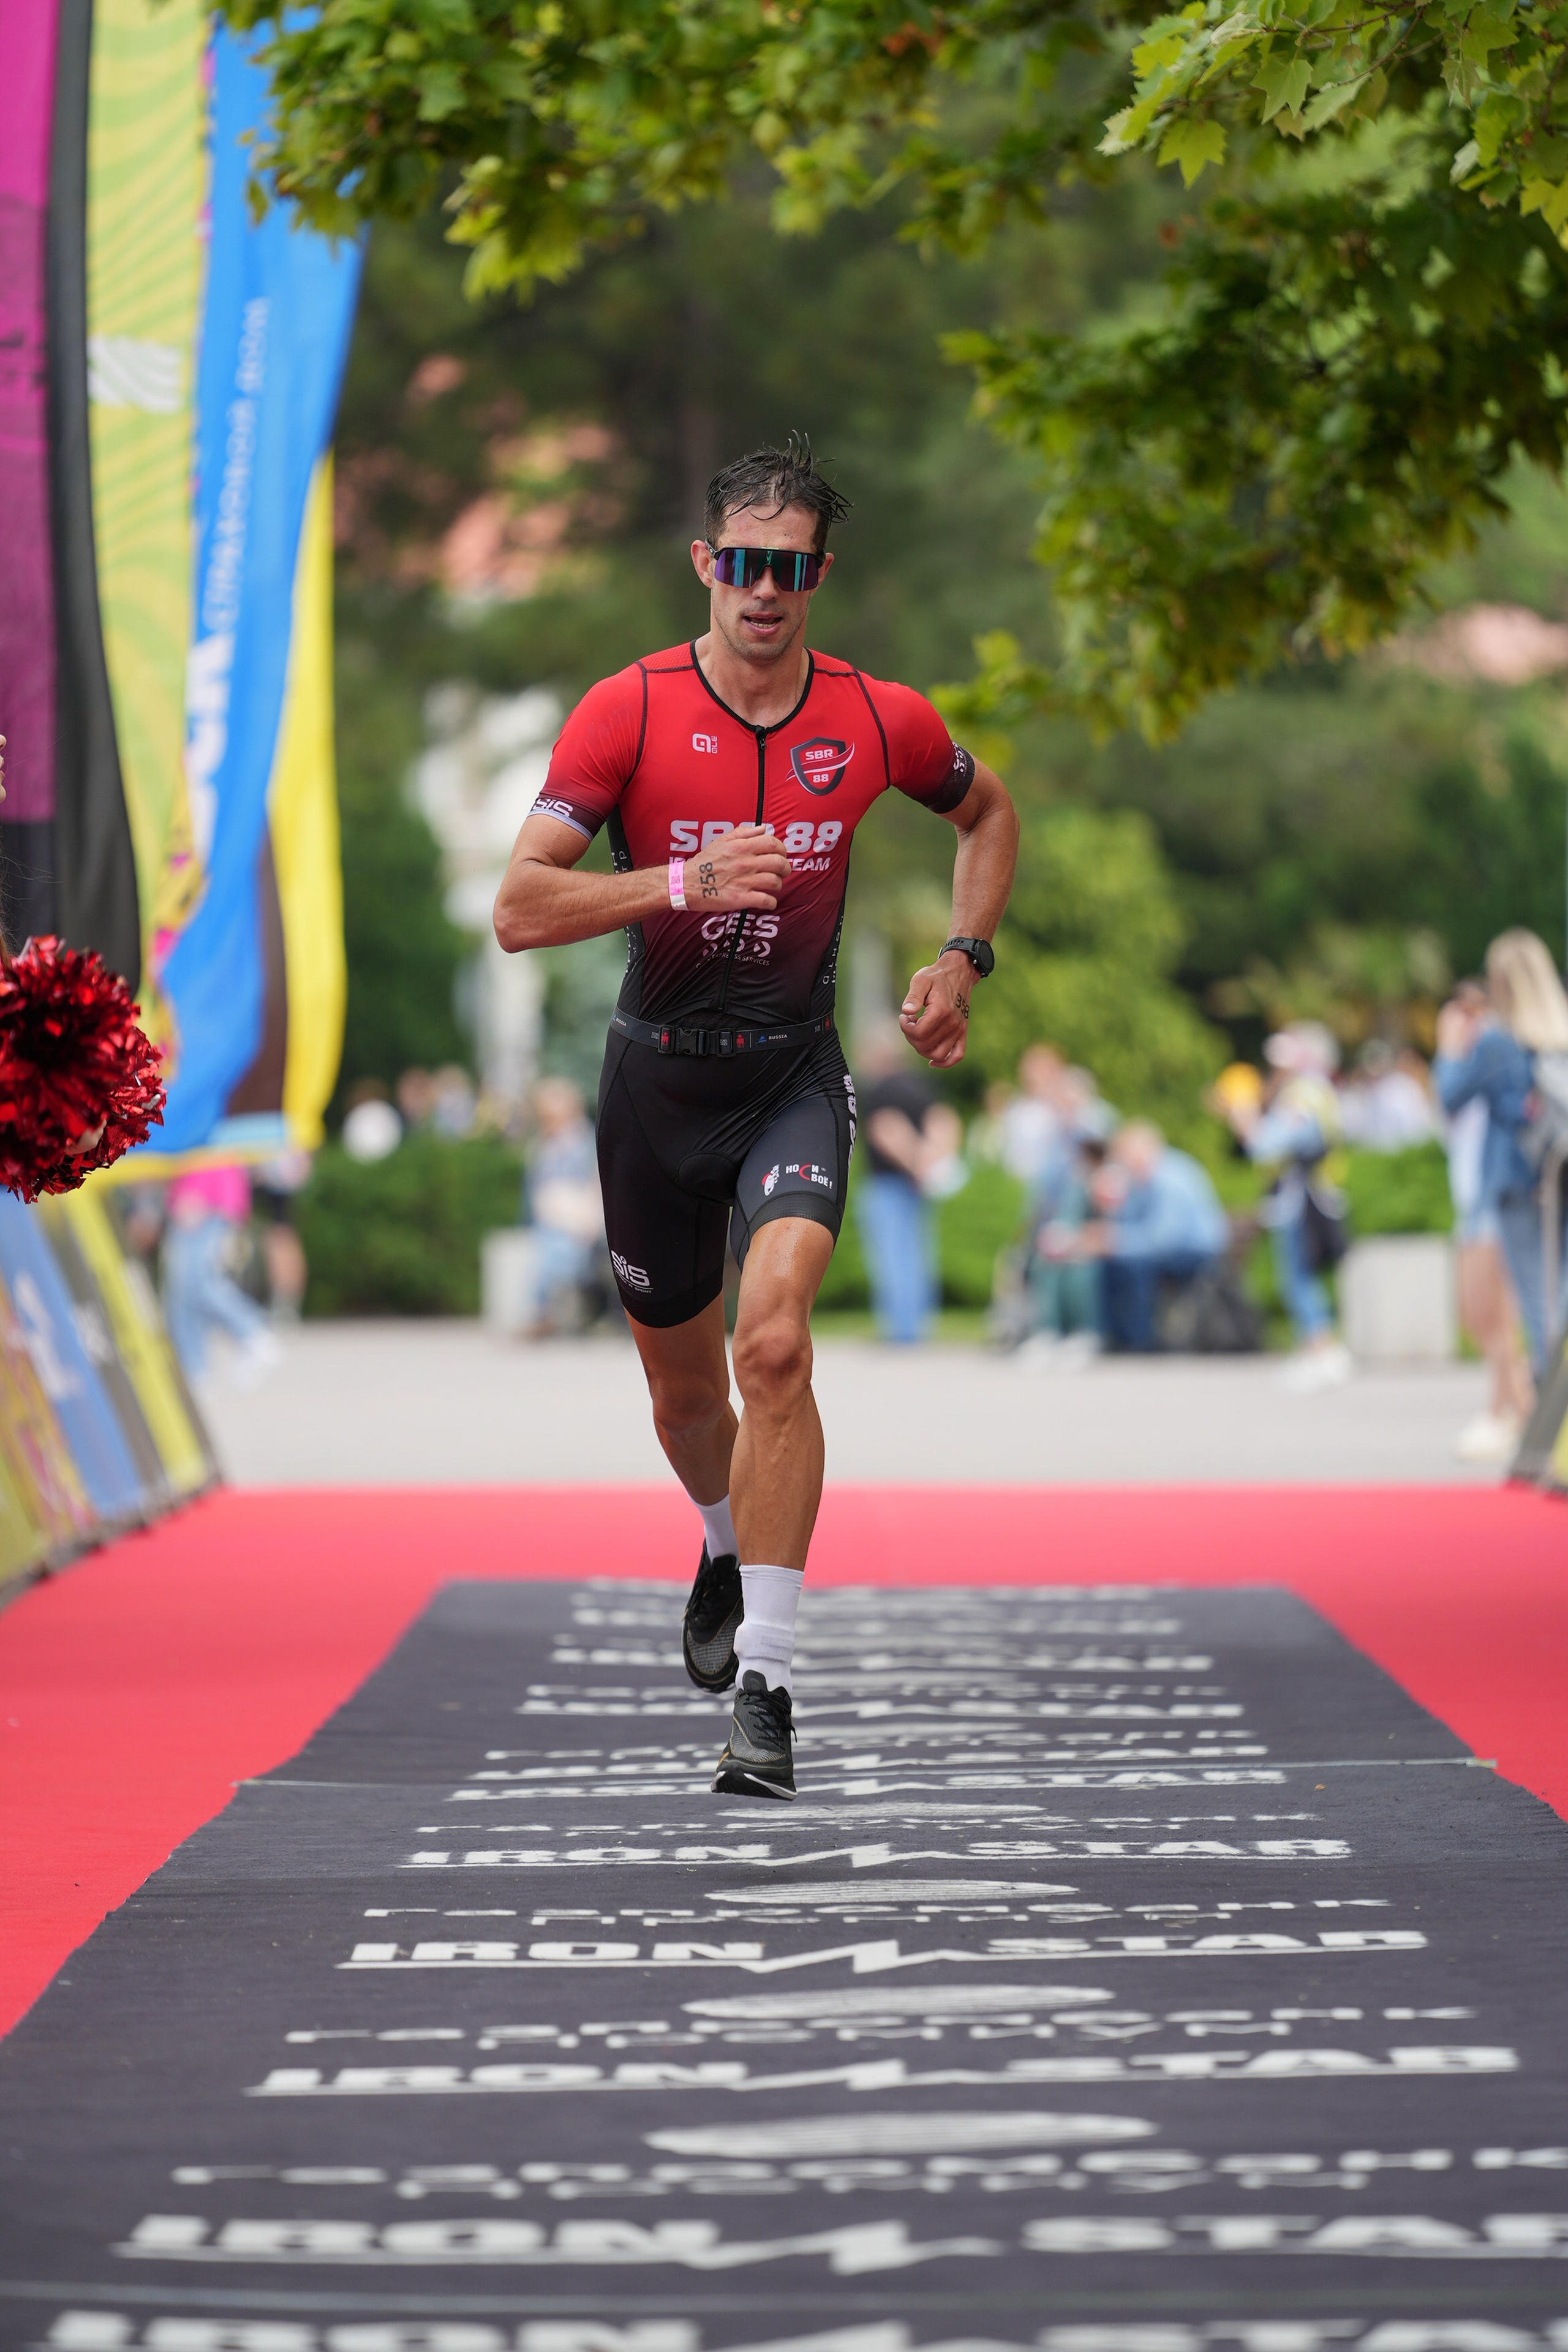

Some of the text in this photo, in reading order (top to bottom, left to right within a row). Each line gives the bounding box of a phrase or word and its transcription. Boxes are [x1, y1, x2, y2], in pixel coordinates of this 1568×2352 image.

[805, 748, 834, 761] SBR
[813, 774, 829, 783] 88
[670, 820, 843, 853] SB 88
[699, 862, 718, 899] 358
[701, 912, 781, 941] GES
[742, 956, 771, 967] SERVICES
[956, 992, 970, 1019] 358
[616, 1017, 627, 1027] RUSSIA
[611, 1250, 650, 1287] SiS
[410, 1839, 1351, 1864] IRON STAR
[350, 1931, 1429, 1961] IRON STAR
[263, 2045, 1520, 2087] IRON STAR
[130, 2214, 720, 2252] IRON
[49, 2311, 1568, 2352] IRON STA
